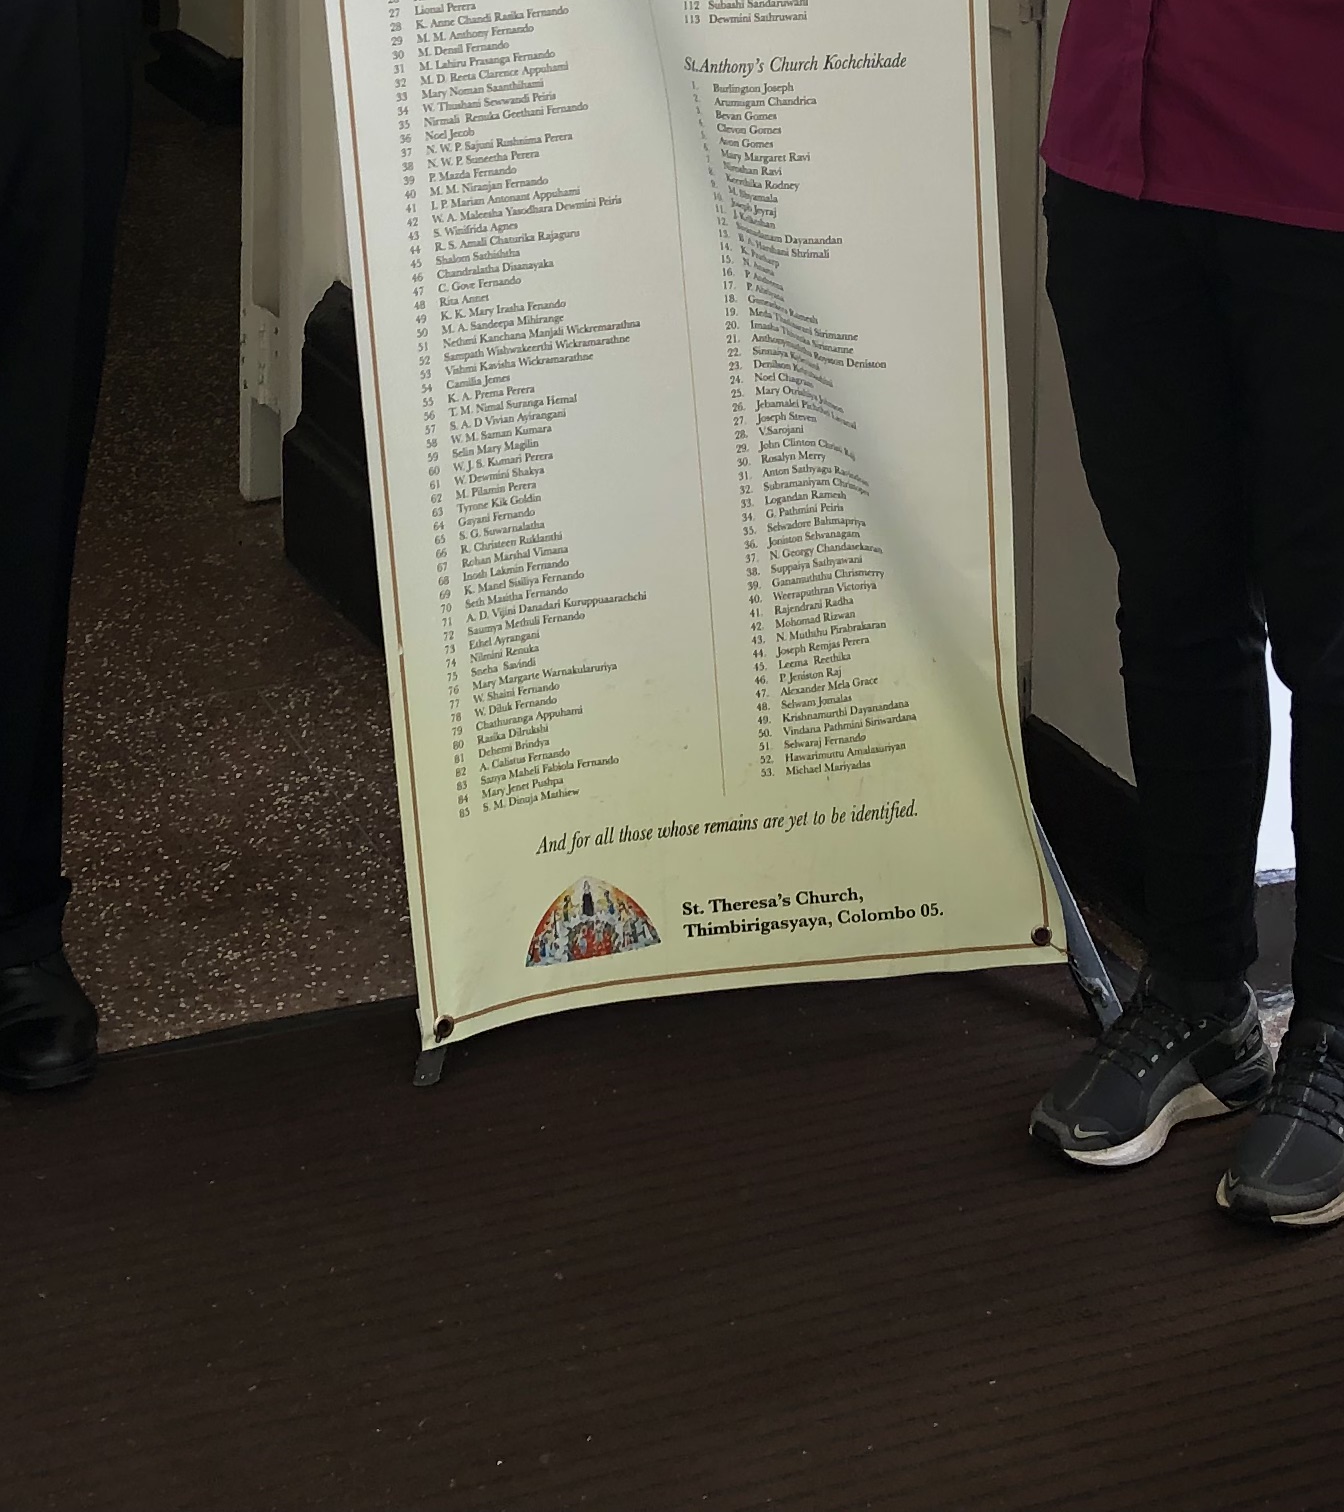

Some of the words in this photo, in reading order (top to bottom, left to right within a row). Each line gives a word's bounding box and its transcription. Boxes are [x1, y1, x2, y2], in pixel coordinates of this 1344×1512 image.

[770, 55, 818, 73] Church
[823, 52, 907, 71] Kochchikade
[398, 120, 410, 130] 35
[424, 114, 460, 127] Nirmali
[465, 111, 500, 122] Renuka
[502, 106, 544, 119] Geethani
[547, 102, 589, 114] Fernando
[427, 452, 439, 462] 59
[477, 444, 502, 457] Mary
[737, 457, 751, 467] 30.
[761, 453, 796, 465] Rosalyn
[798, 450, 826, 463] Merry
[740, 498, 754, 508] 33.
[764, 492, 809, 505] Logandan
[811, 489, 847, 500] Ramesh
[433, 521, 444, 531] 64
[458, 514, 490, 527] Gayani
[493, 508, 536, 521] Fernando
[742, 512, 755, 522] 34.
[766, 509, 777, 519] G.
[779, 504, 818, 517] Pathmini
[820, 503, 844, 513] Peiris
[751, 622, 764, 631] 42.
[823, 611, 856, 622] Rizwan
[445, 658, 457, 668] 74
[470, 649, 503, 663] Nilmini
[506, 644, 540, 656] Renuka
[452, 726, 463, 736] 79
[475, 713, 534, 731] Chathuranga
[536, 705, 584, 722] Appuhami
[760, 768, 775, 778] 53.
[785, 764, 822, 776] Michael
[824, 761, 871, 773] Mariyadas
[535, 833, 567, 855] And
[567, 831, 591, 855] for
[595, 827, 615, 846] all
[619, 825, 654, 843] those
[657, 820, 700, 839] whose
[704, 813, 758, 833] remains
[763, 815, 785, 829] are
[785, 812, 808, 832] yet
[813, 811, 826, 825] to
[831, 807, 846, 824] be
[851, 799, 918, 824] identified.
[682, 902, 705, 916] St.
[708, 893, 791, 914] Theresa's
[795, 887, 864, 906] Church,
[683, 918, 833, 938] Thimbirigasyaya,
[837, 906, 916, 924] Colombo
[921, 903, 944, 918] 05.
